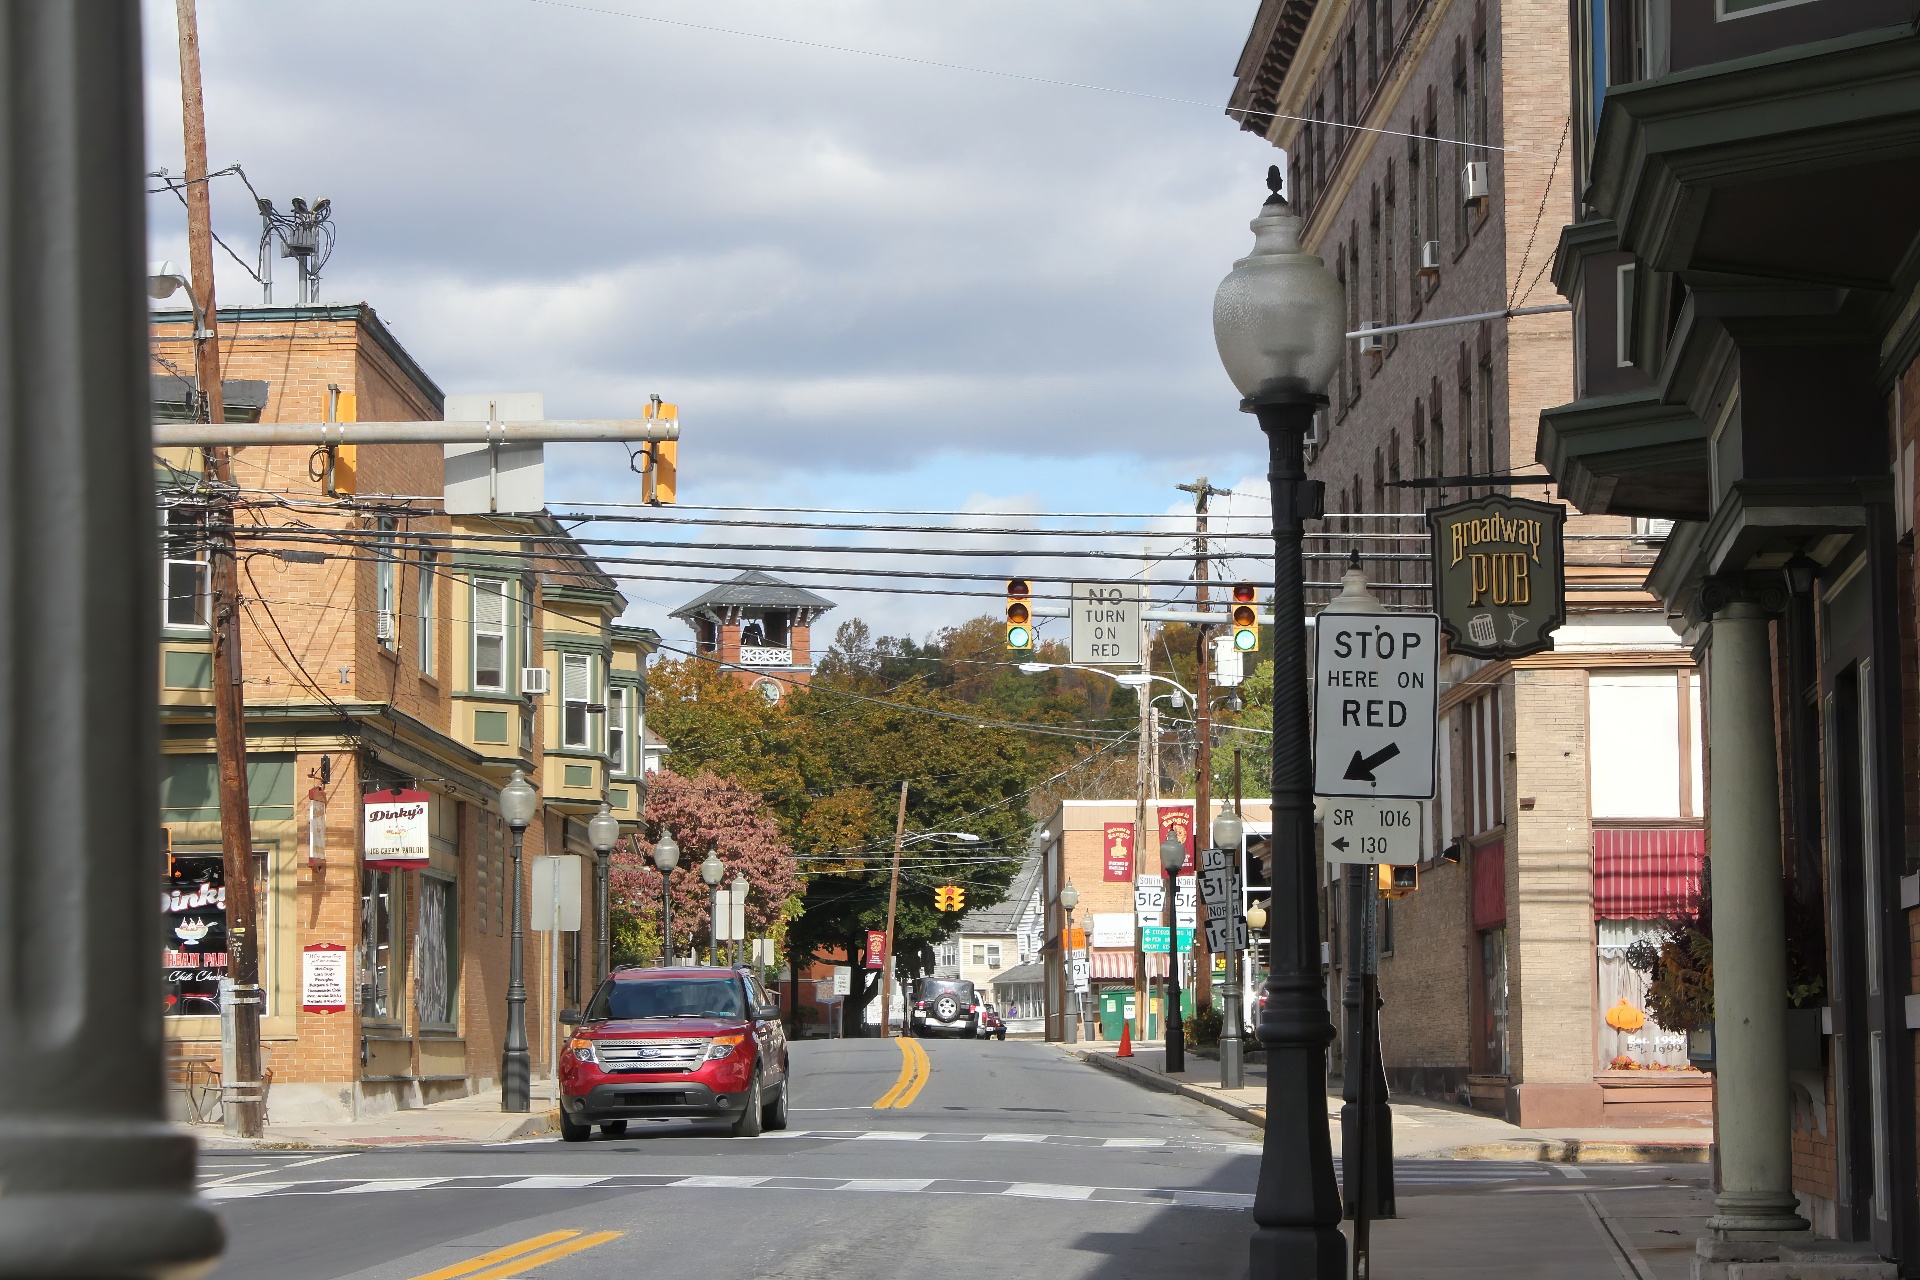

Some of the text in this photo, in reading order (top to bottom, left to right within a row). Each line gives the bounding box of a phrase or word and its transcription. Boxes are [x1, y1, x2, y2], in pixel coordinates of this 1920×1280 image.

[1450, 511, 1542, 569] Broadway
[1468, 553, 1531, 607] PUB
[1089, 588, 1122, 605] NO
[1085, 610, 1125, 622] TURN
[1094, 627, 1116, 639] ON
[1091, 644, 1120, 656] RED
[1333, 631, 1421, 659] STOP
[1328, 670, 1424, 688] HERE ON
[1342, 699, 1407, 727] RED
[369, 805, 424, 822] Dinky's
[1333, 809, 1411, 827] SR 1016
[1162, 817, 1189, 828] Bangor
[1360, 836, 1387, 853] 130
[1140, 877, 1161, 885] SOUTH
[1138, 893, 1161, 906] 512
[1175, 894, 1197, 907] 512
[1209, 905, 1239, 917] NORH
[1073, 964, 1086, 974] 91
[1655, 1035, 1685, 1045] 1999
